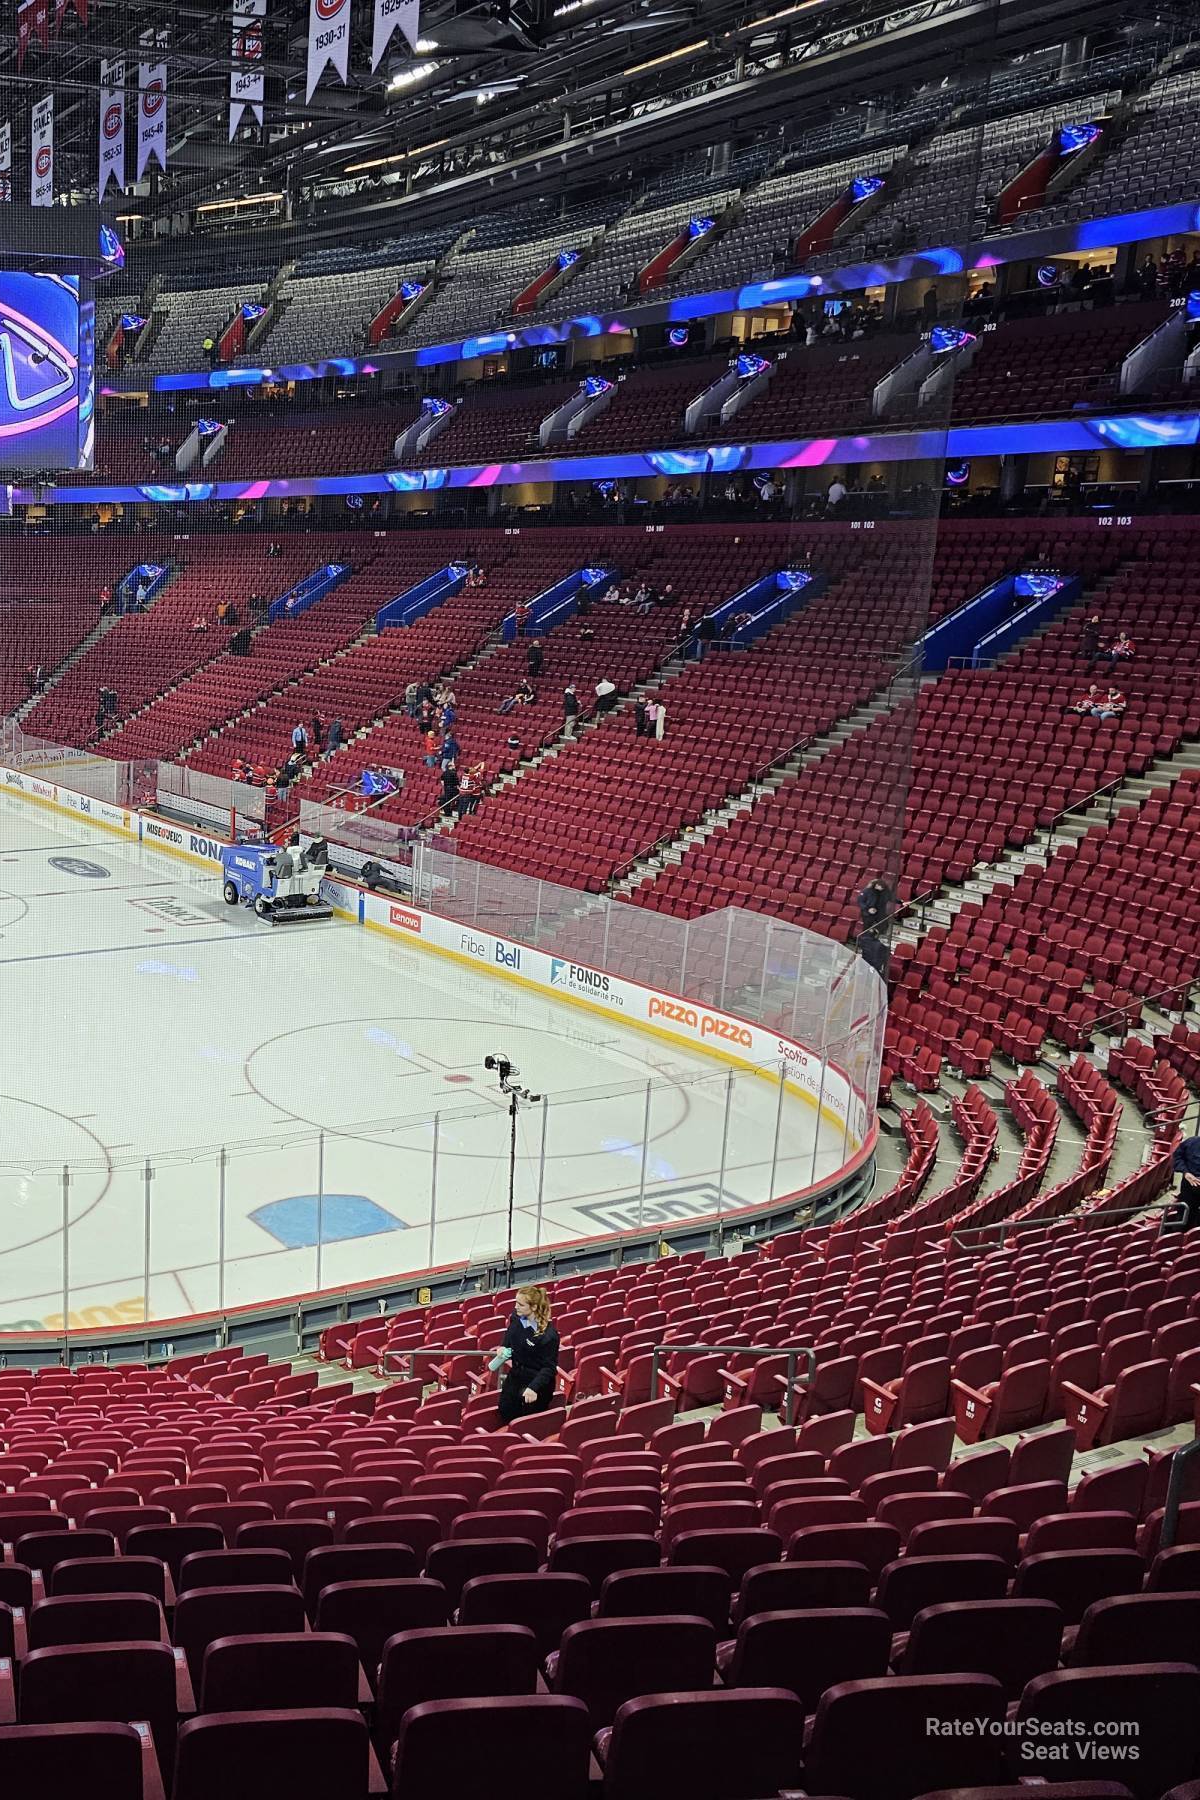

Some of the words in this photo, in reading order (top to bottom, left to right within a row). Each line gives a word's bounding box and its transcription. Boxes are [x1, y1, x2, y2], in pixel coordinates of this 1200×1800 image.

[315, 23, 346, 50] 1930-31
[1170, 297, 1186, 307] 202
[983, 323, 997, 331] 202
[864, 521, 875, 529] 102
[1098, 517, 1112, 525] 102
[1117, 516, 1132, 525] 103
[80, 797, 91, 813] Bell
[392, 910, 419, 928] Lenovo
[461, 934, 485, 957] Fibe
[495, 941, 521, 970] Bell
[570, 964, 610, 991] FONDS
[569, 981, 577, 989] de
[578, 984, 609, 1001] solidarité
[610, 994, 624, 1006] FTQ
[648, 997, 698, 1029] pizza
[701, 1015, 753, 1049] pizza
[777, 1040, 808, 1066] Scotia
[874, 1397, 882, 1408] G
[967, 1400, 975, 1412] H
[1080, 1404, 1087, 1415] J
[1077, 1413, 1088, 1424] 107
